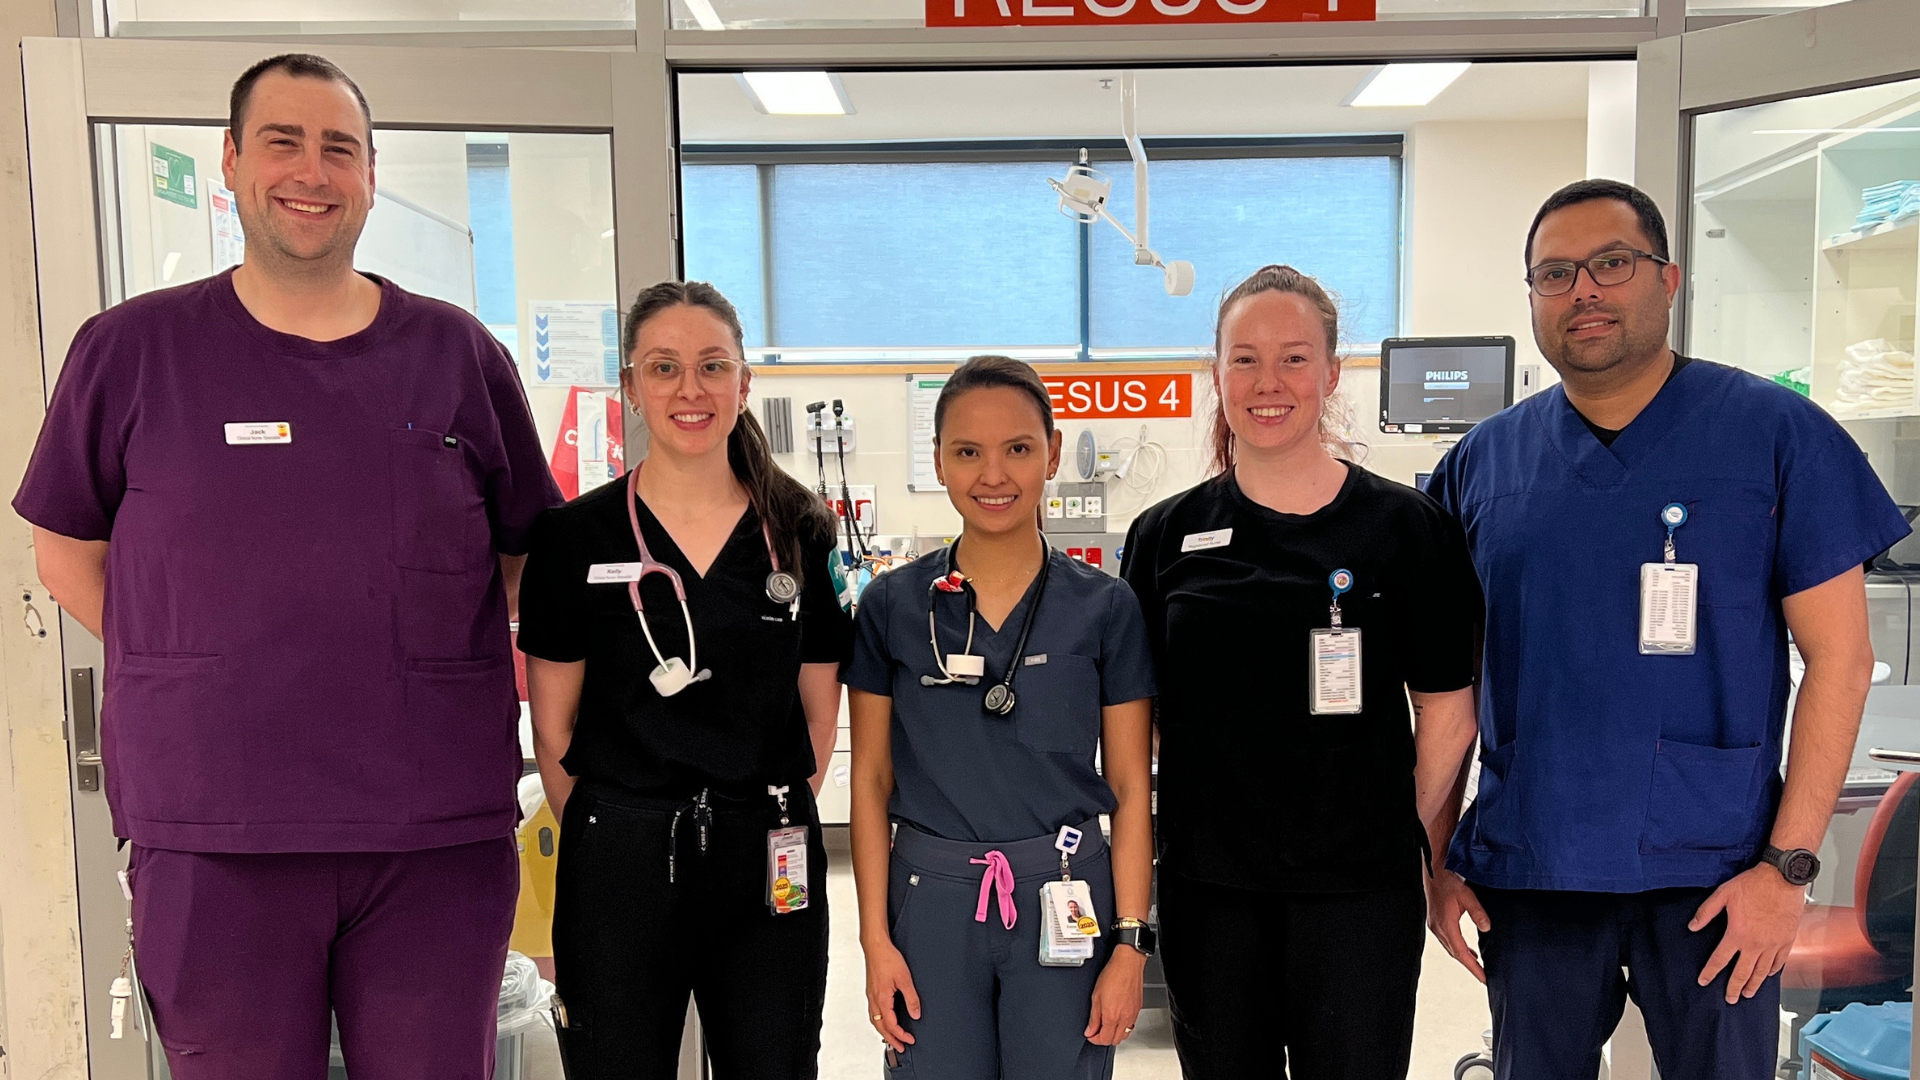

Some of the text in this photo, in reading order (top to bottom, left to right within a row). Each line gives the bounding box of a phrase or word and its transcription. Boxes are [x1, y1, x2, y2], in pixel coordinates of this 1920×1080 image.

[1425, 370, 1468, 381] PHILIPS
[1042, 379, 1180, 413] ESUS 4
